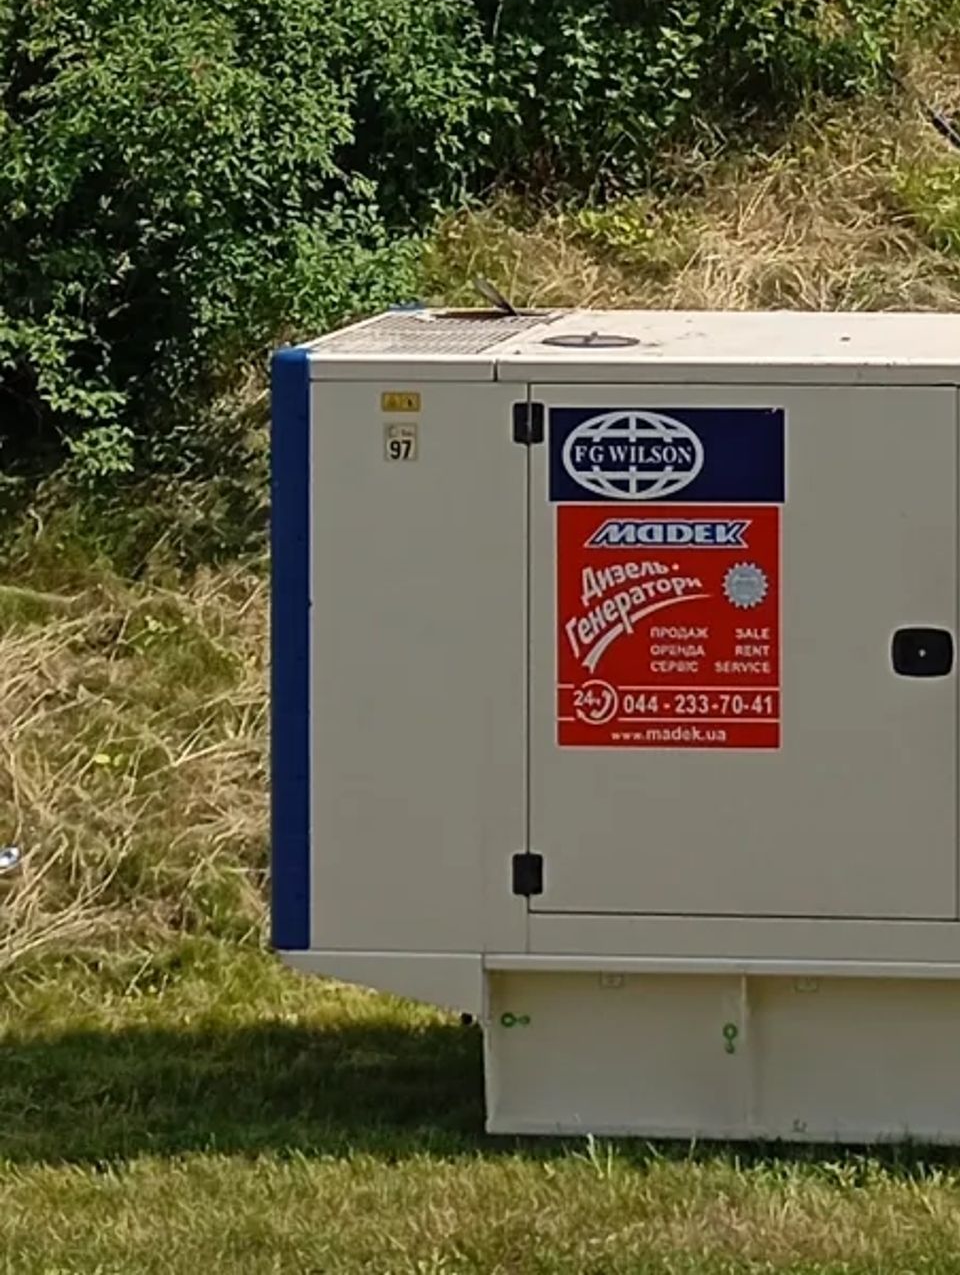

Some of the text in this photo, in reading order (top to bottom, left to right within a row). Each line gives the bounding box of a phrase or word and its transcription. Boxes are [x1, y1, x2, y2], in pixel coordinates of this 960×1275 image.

[389, 439, 412, 460] 97
[574, 445, 692, 464] FG WILSON
[594, 524, 746, 545] MADEK
[565, 577, 702, 659] Генератори
[650, 626, 709, 640] ПРОДАЖ
[735, 627, 770, 639] SALE
[650, 644, 705, 656] ОРЕНДА
[735, 645, 770, 656] RENT
[714, 661, 770, 673] SERVICE
[611, 726, 726, 741] www.madek.ua
